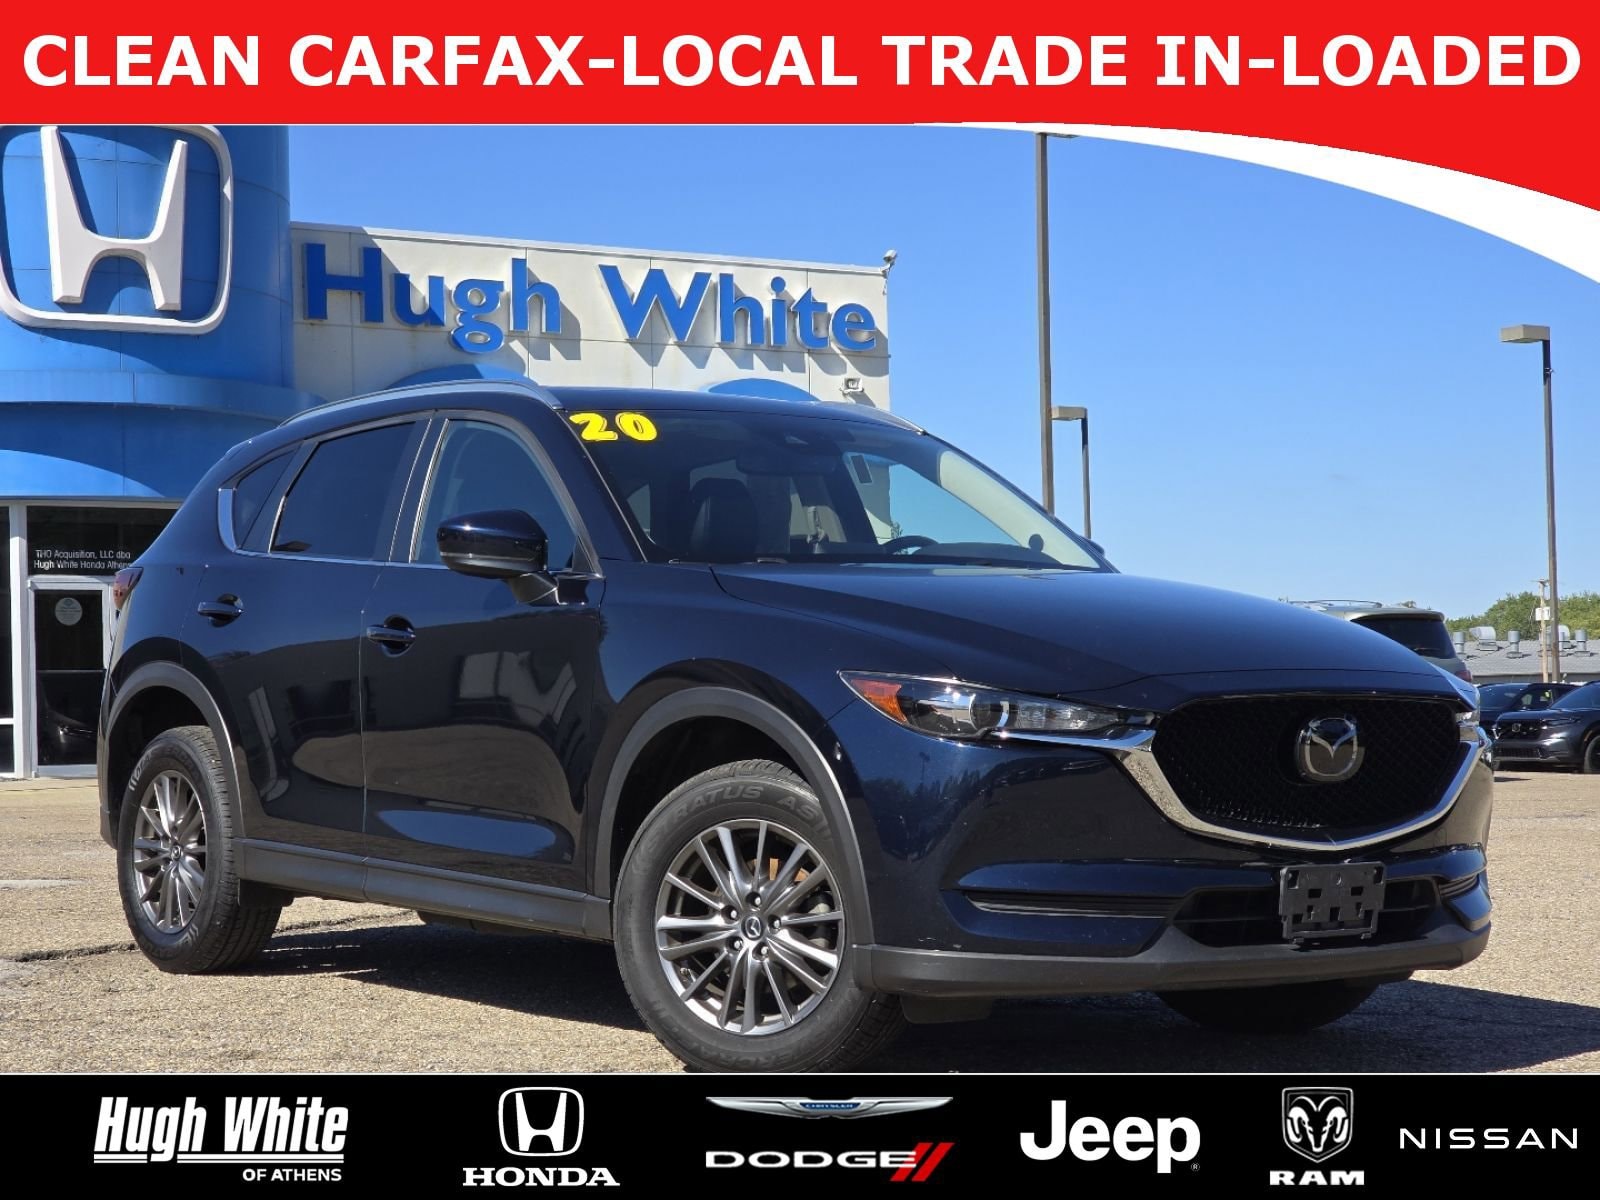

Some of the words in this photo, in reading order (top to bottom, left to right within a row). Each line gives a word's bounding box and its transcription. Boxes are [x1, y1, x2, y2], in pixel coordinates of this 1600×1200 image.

[304, 242, 562, 355] Hugh
[599, 264, 876, 351] White
[569, 411, 658, 443] 20
[99, 550, 114, 559] LLC
[33, 560, 55, 571] Hugh
[56, 560, 78, 569] White
[80, 561, 105, 569] Honda
